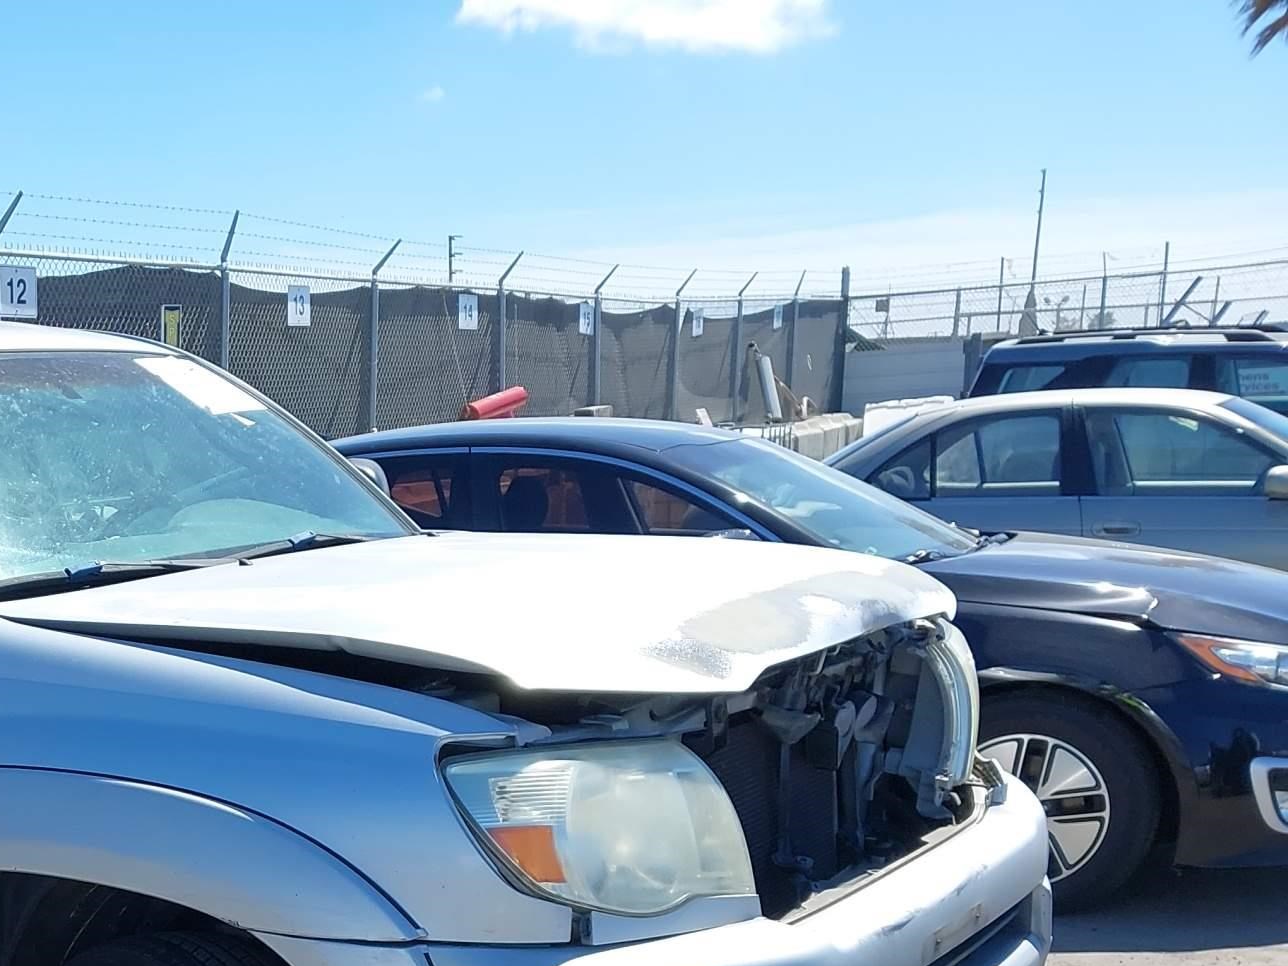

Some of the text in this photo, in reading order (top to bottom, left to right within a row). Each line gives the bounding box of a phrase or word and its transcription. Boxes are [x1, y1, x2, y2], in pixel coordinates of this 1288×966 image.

[7, 277, 27, 304] 12
[293, 294, 305, 316] 13
[463, 303, 473, 321] 14
